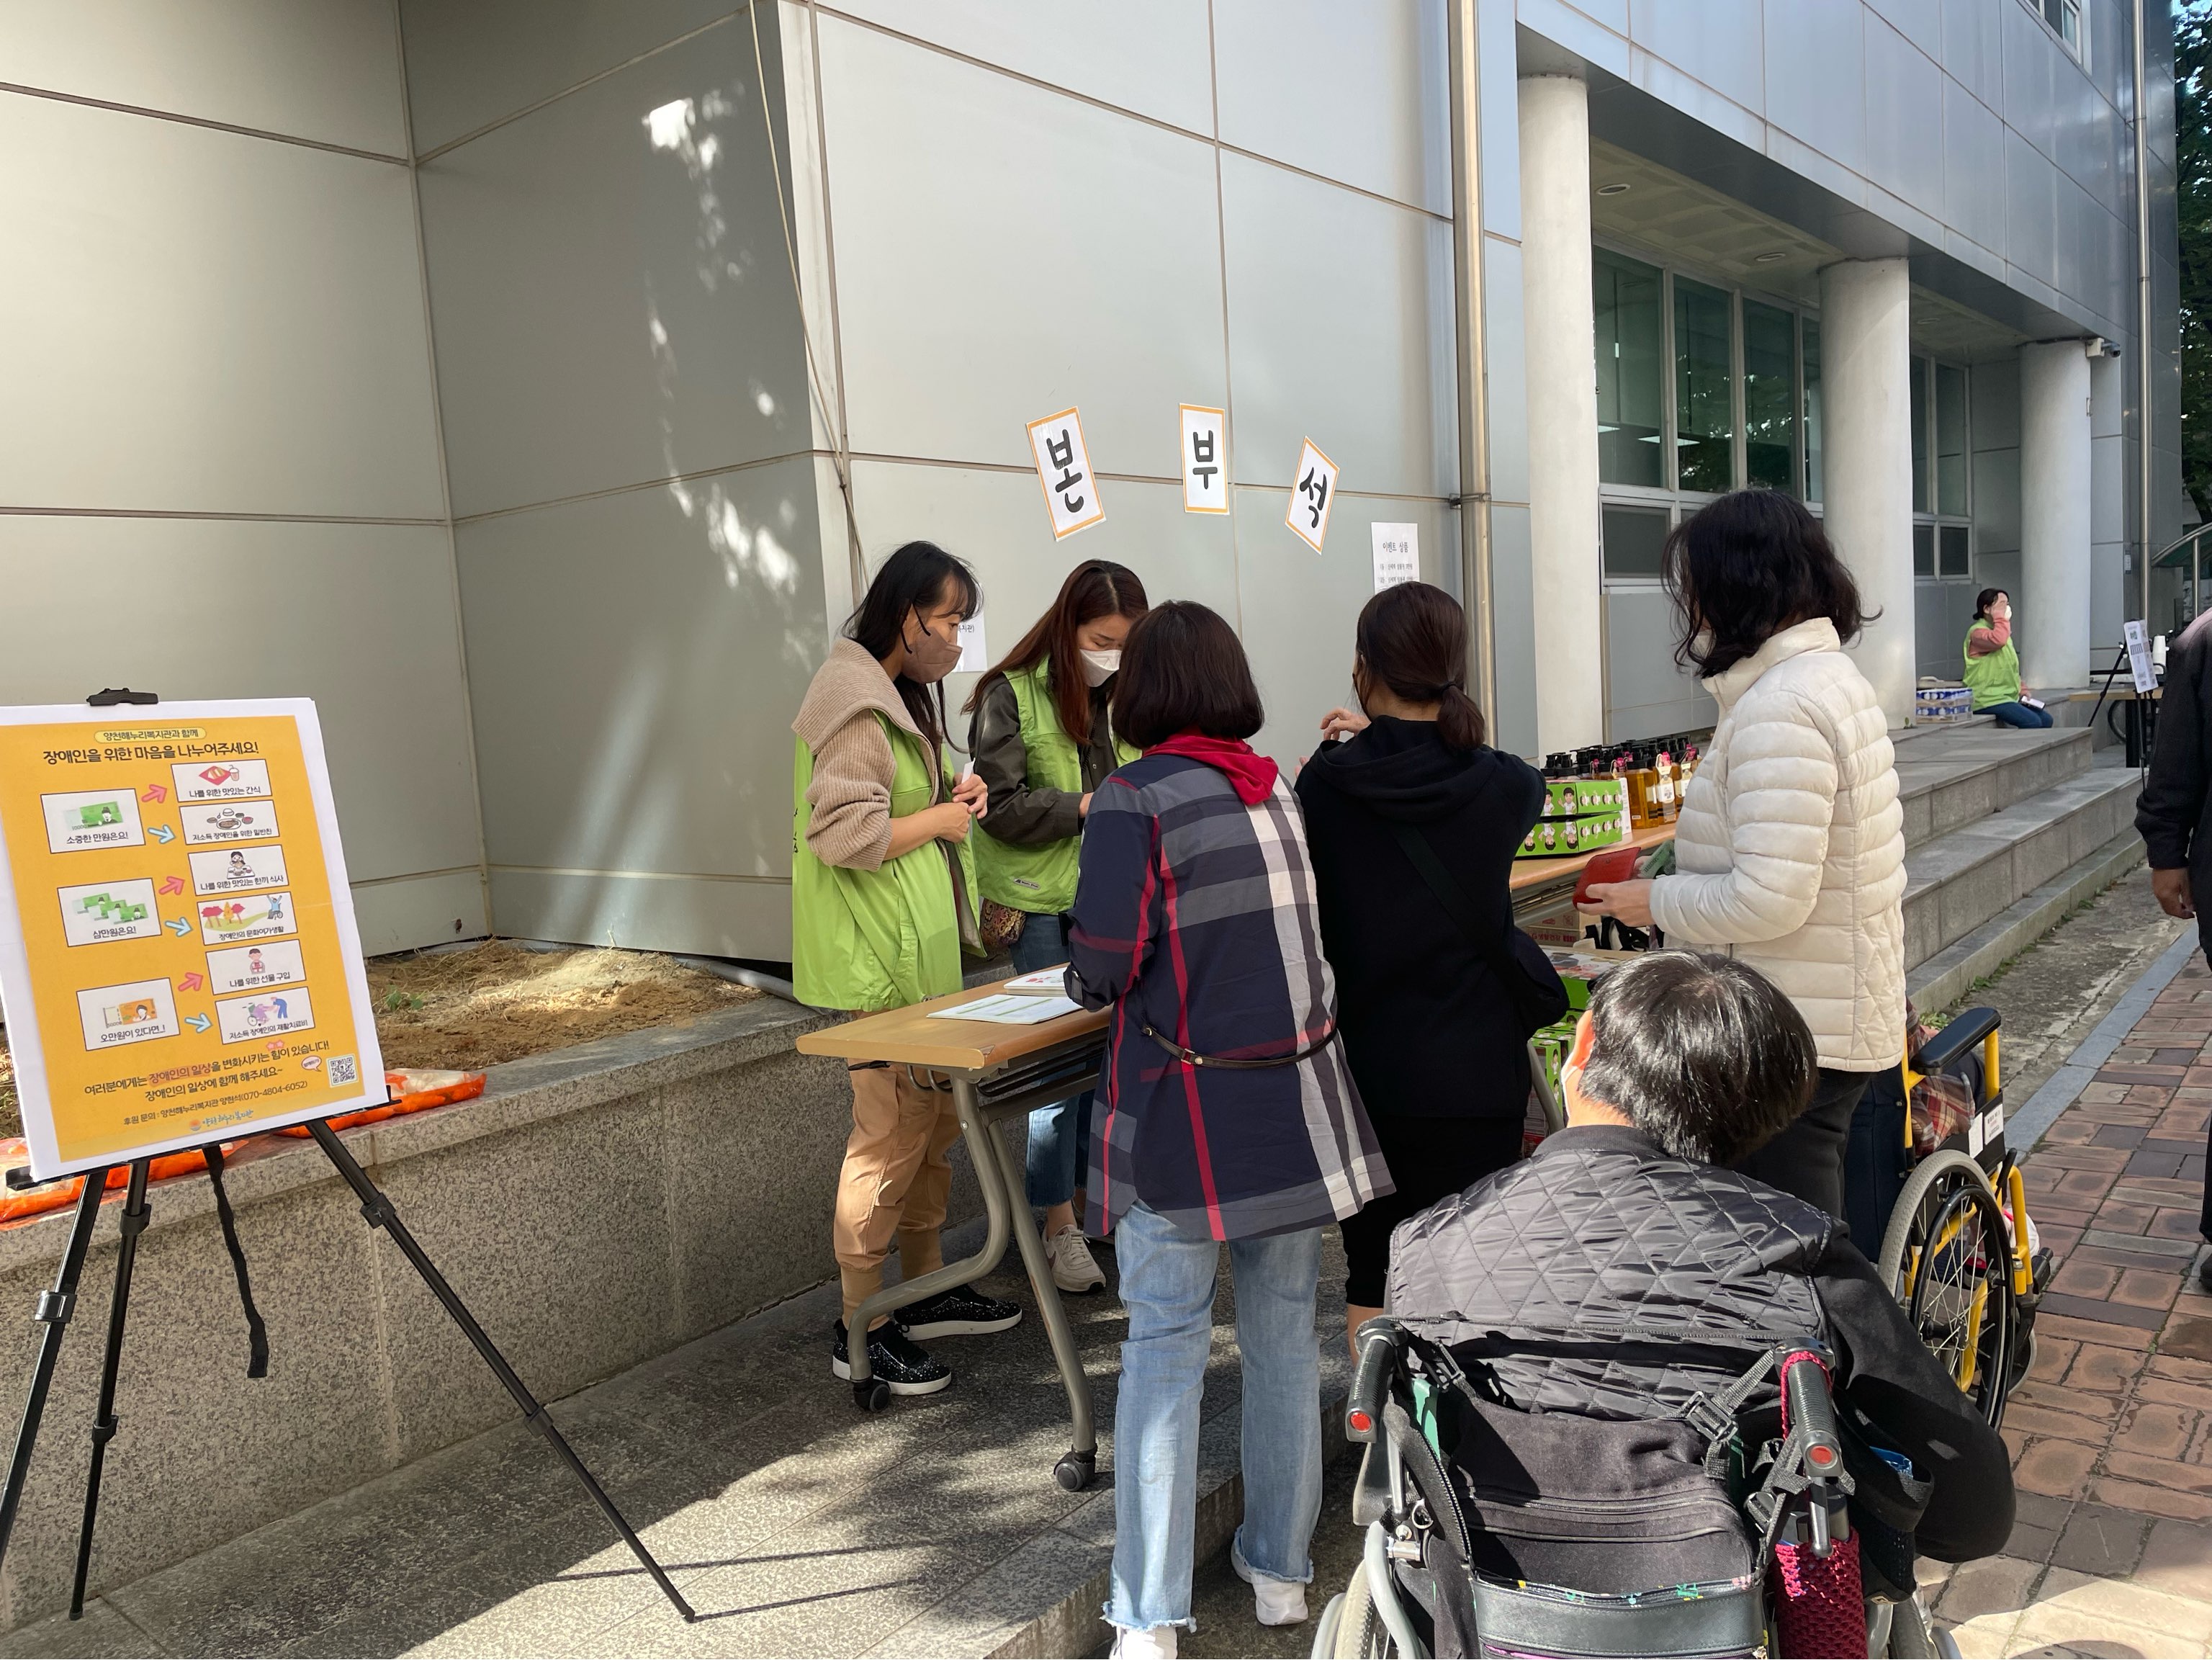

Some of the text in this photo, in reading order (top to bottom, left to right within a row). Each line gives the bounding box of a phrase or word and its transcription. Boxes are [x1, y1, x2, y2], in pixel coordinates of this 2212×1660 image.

[1046, 429, 1328, 529] 본 부 석
[103, 729, 199, 741] 양천해누리복지관과 함께
[43, 741, 259, 765] 장애인을 위한 마음을 나누어주세요!
[189, 786, 261, 798] 나를 위한 맛있는 간식
[66, 835, 91, 844] 소중한
[214, 832, 239, 840] 장애인을
[217, 881, 230, 889] 위한
[232, 879, 253, 887] 맛있는
[255, 876, 269, 885] 한끼
[219, 932, 245, 941] 장애인의
[230, 972, 290, 987] 나를 위한 선물 구입
[101, 1031, 133, 1043] 오만원이
[229, 1030, 249, 1040] 저소득
[250, 1026, 276, 1036] 장애인의
[84, 1040, 330, 1095] 여러분에게는 장애인의 일상을 변화시키는 힘이 있습니다!
[145, 1067, 283, 1102] 장애인의 일상에 함께 해주세요~
[124, 1116, 139, 1125] 후원
[140, 1111, 156, 1122] 문의
[160, 1099, 219, 1118] 양천해누리복지관
